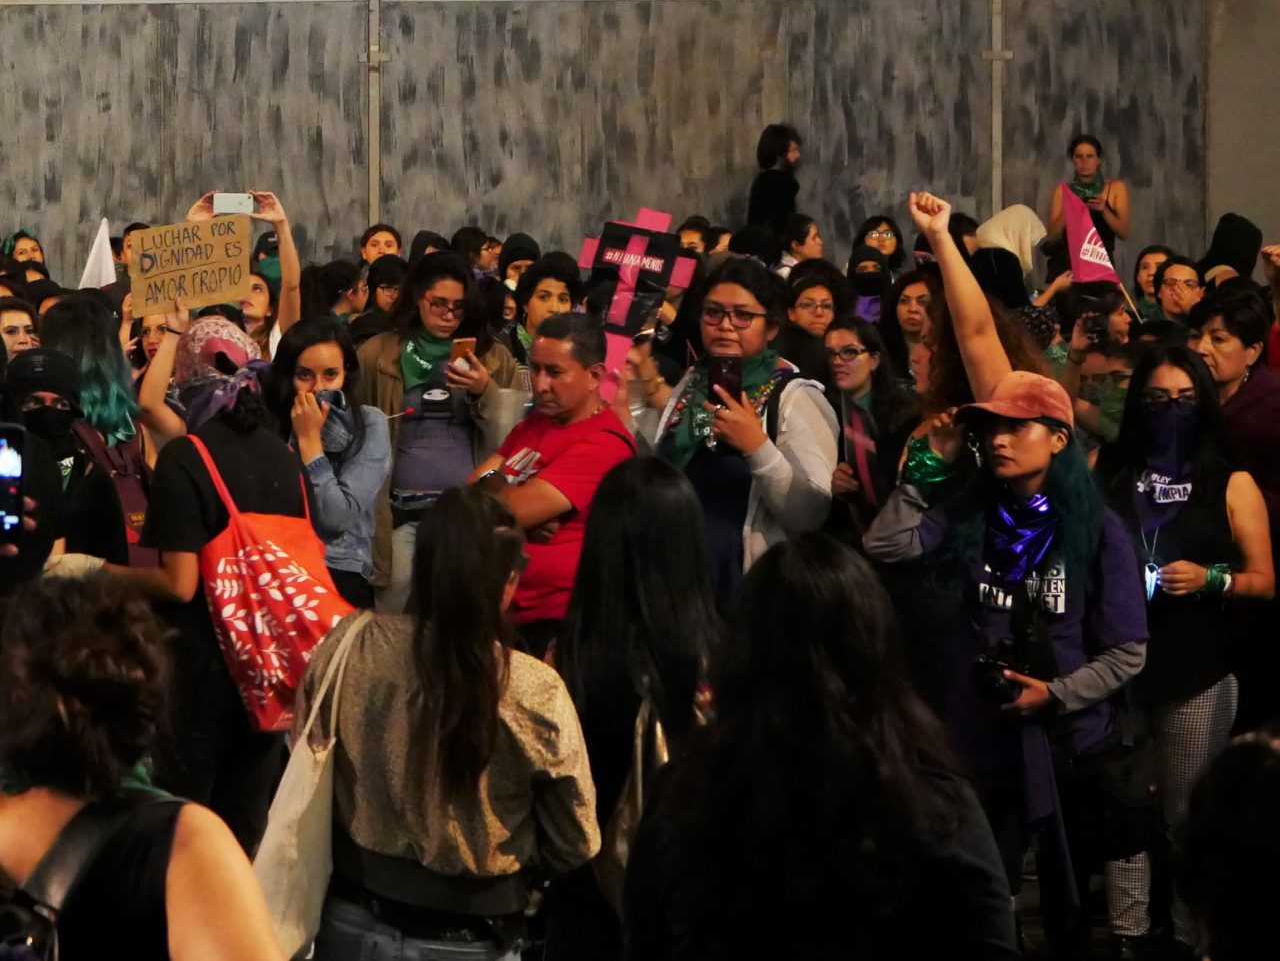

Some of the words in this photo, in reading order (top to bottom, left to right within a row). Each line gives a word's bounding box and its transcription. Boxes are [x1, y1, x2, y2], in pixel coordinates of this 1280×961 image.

[140, 225, 201, 253] LUCHAR
[211, 221, 236, 237] POR
[139, 243, 214, 274] DIGNIDAD
[224, 241, 242, 258] ES
[145, 277, 187, 304] AMOR
[192, 264, 242, 296] PROPIO
